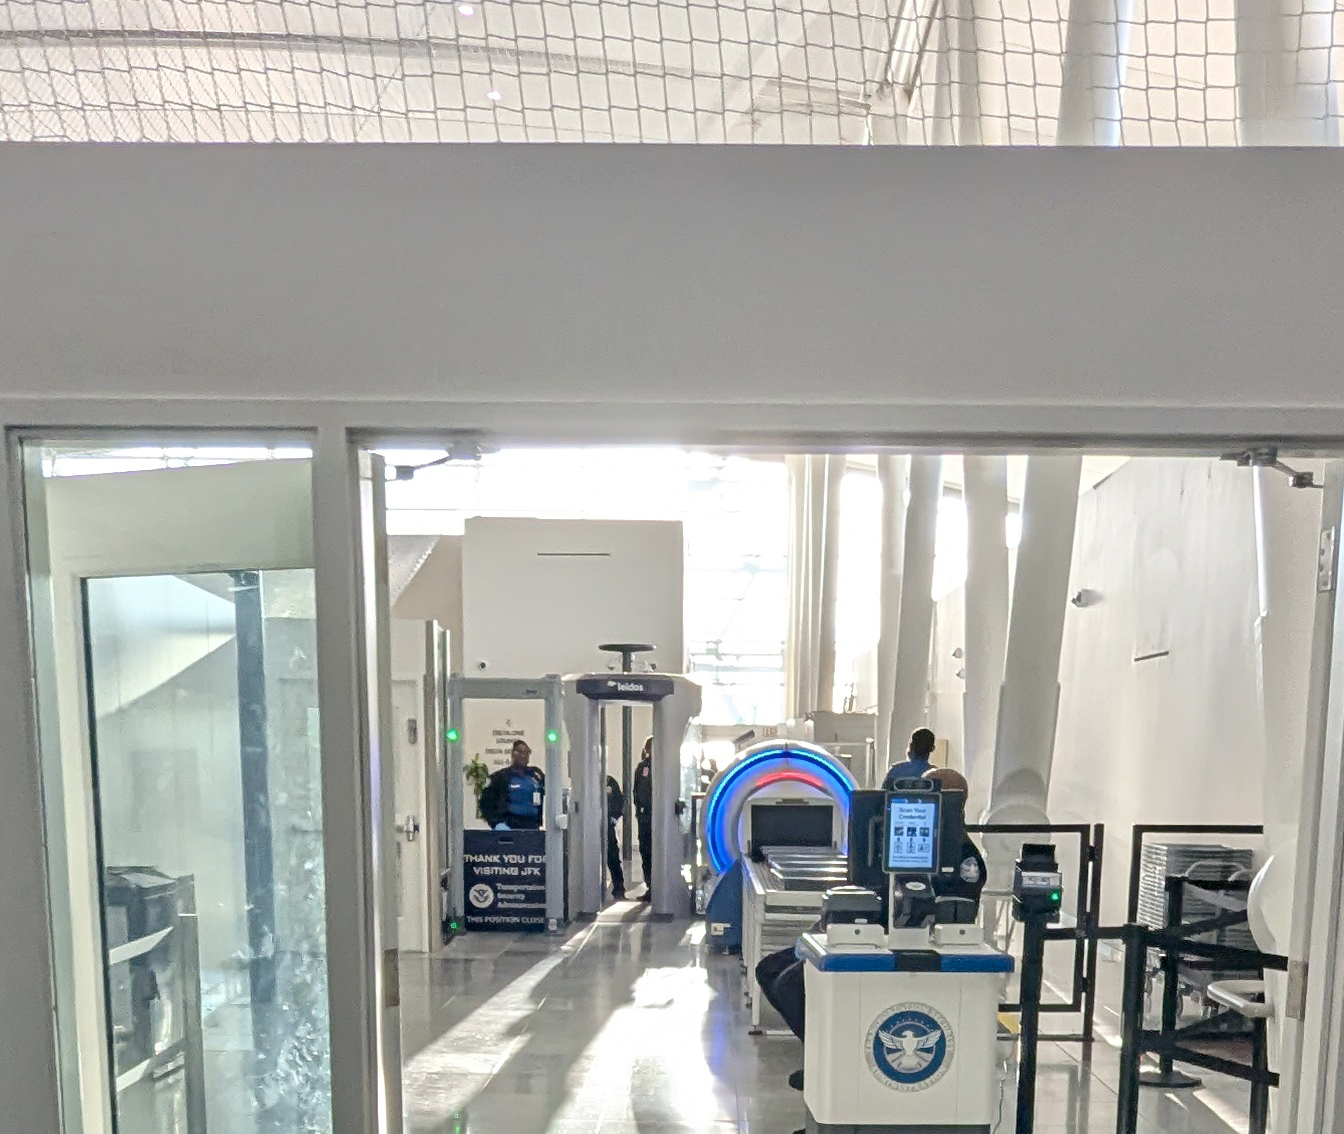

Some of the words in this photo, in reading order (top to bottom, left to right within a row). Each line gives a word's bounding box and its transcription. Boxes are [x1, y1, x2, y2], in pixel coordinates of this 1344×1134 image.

[617, 681, 644, 692] leidos
[464, 854, 500, 863] THANK
[503, 854, 525, 864] YOU
[473, 867, 518, 875] VISITING
[521, 867, 541, 875] JFK
